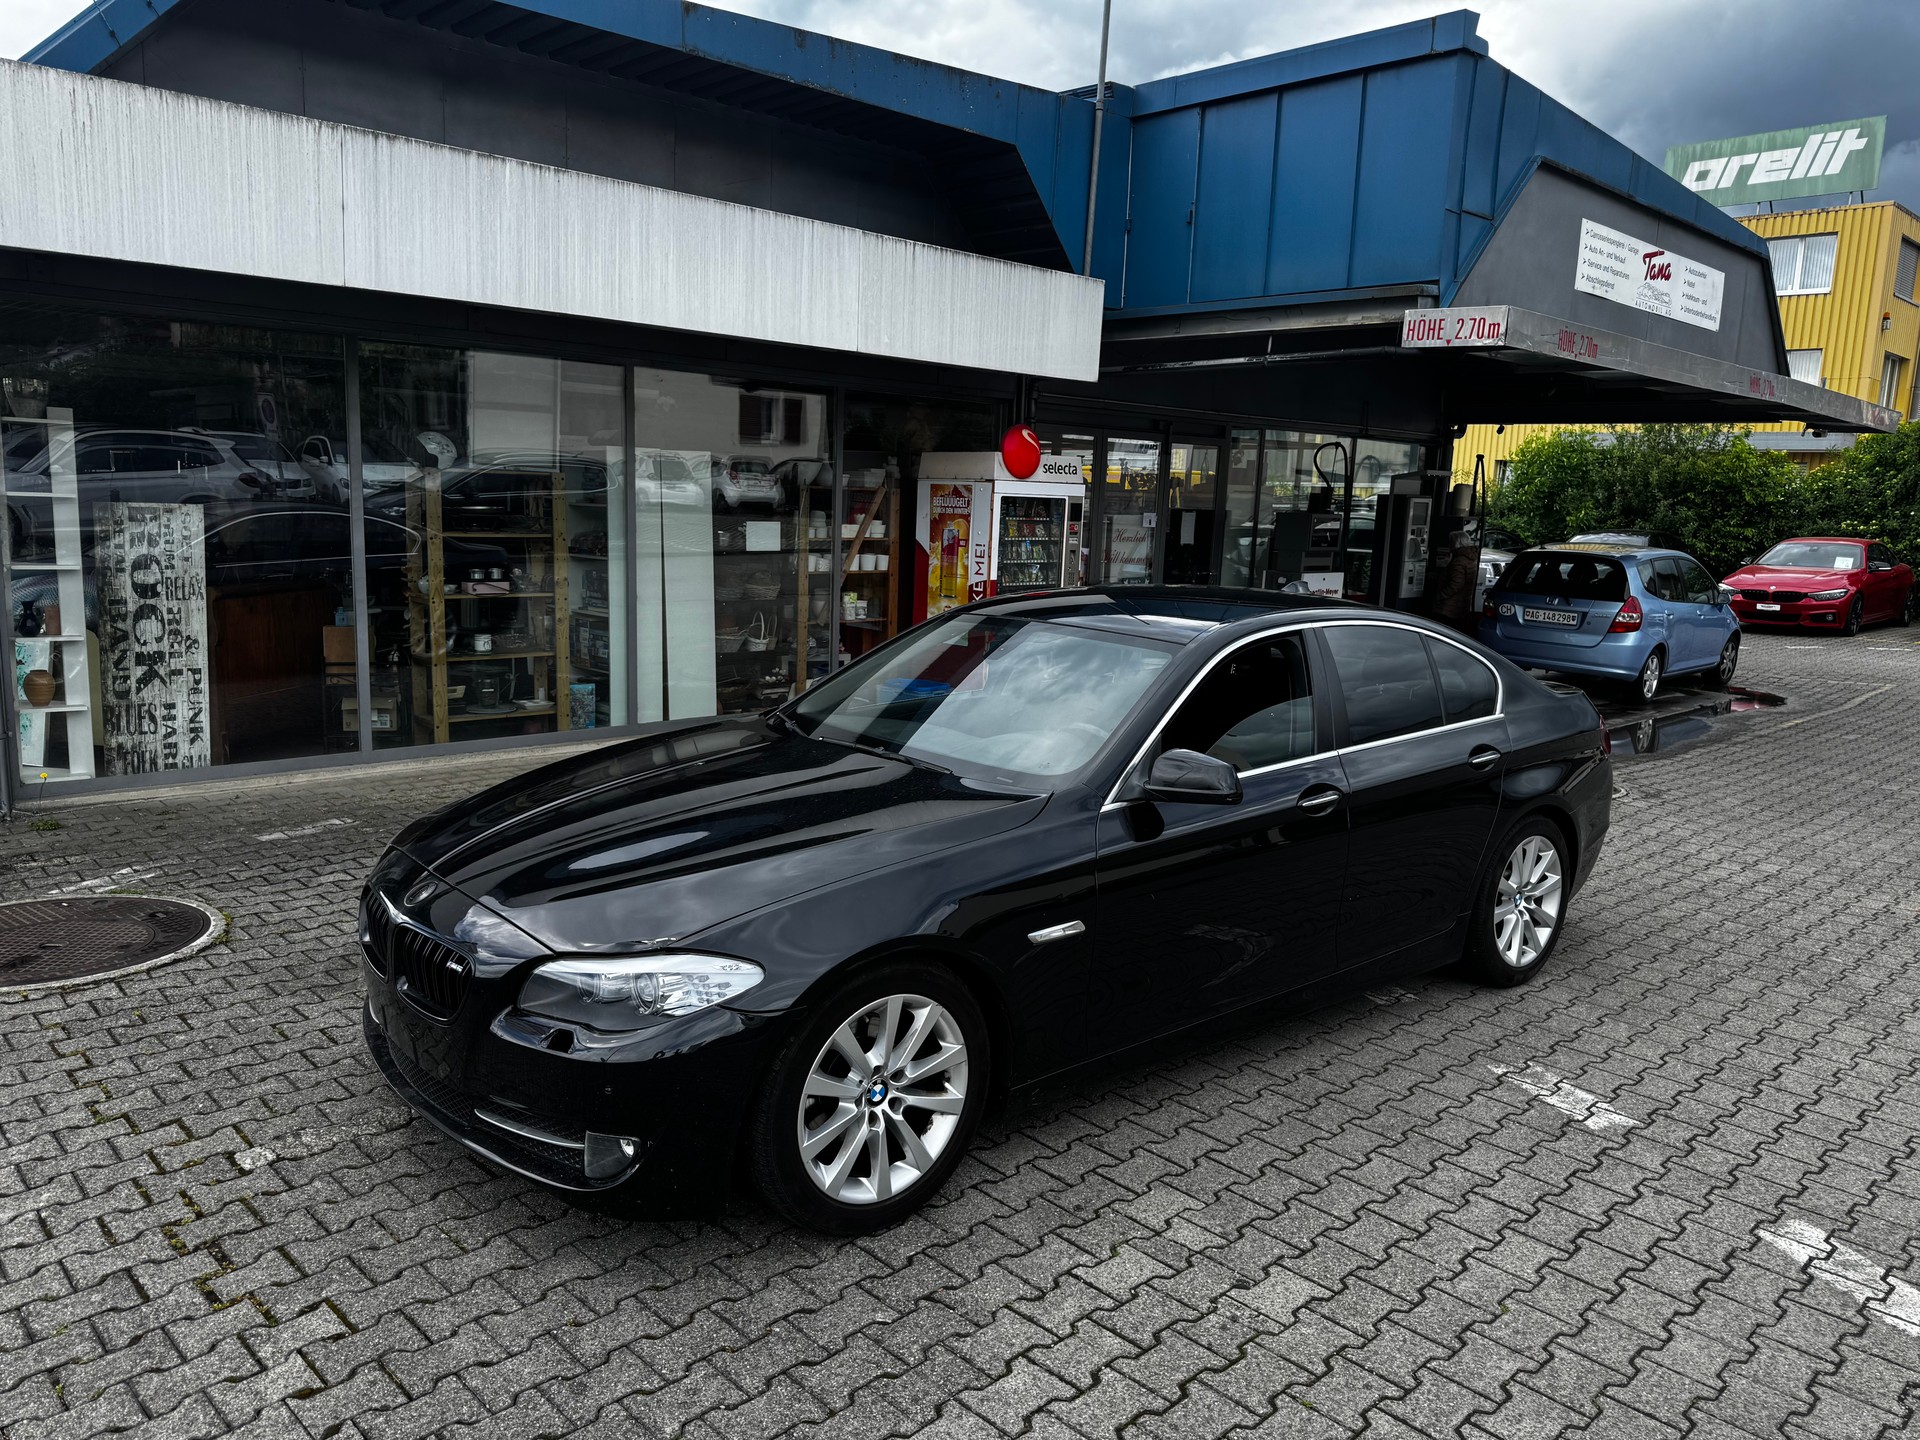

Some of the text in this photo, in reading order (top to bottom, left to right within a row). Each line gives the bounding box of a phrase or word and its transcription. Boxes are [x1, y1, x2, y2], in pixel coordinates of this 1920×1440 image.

[1681, 127, 1869, 192] orelit
[1589, 244, 1598, 254] Auto
[1613, 252, 1626, 264] Verkauf
[1627, 243, 1640, 256] Garage
[1587, 258, 1630, 280] Service und Reparaturen
[1643, 250, 1672, 281] Tana
[1634, 300, 1672, 317] AUTOMOBIL AG
[1406, 314, 1446, 342] HÖHE
[1557, 325, 1577, 354] HÖHE
[1042, 461, 1078, 476] selecta
[1112, 527, 1148, 543] Herzlich
[127, 506, 168, 696] ROCK
[164, 576, 204, 601] RELAX
[1500, 605, 1512, 615] CH
[107, 598, 131, 700] BAND
[166, 606, 184, 686] ROLL
[184, 634, 200, 655] &
[102, 702, 158, 737] BLUES
[186, 667, 204, 748] PUNK
